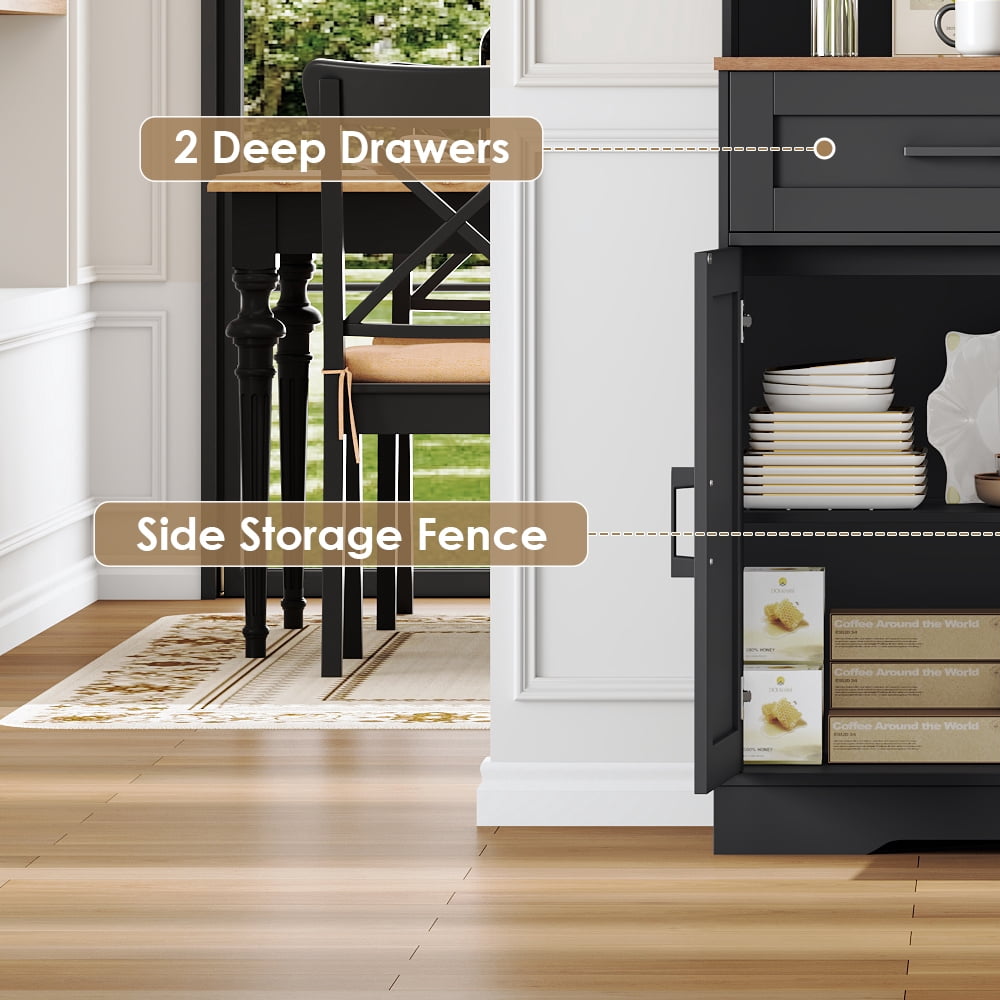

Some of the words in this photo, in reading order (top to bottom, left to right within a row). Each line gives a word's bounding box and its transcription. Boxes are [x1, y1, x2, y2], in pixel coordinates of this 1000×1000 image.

[834, 619, 874, 629] Coffee
[876, 619, 918, 629] Around
[921, 619, 942, 629] the
[944, 619, 980, 629] World
[834, 667, 874, 677] Coffee
[876, 667, 918, 677] Around
[921, 667, 942, 677] the
[944, 667, 980, 677] World
[832, 721, 874, 731] Coffee
[876, 721, 918, 731] Around
[921, 721, 942, 731] the
[944, 721, 980, 731] World
